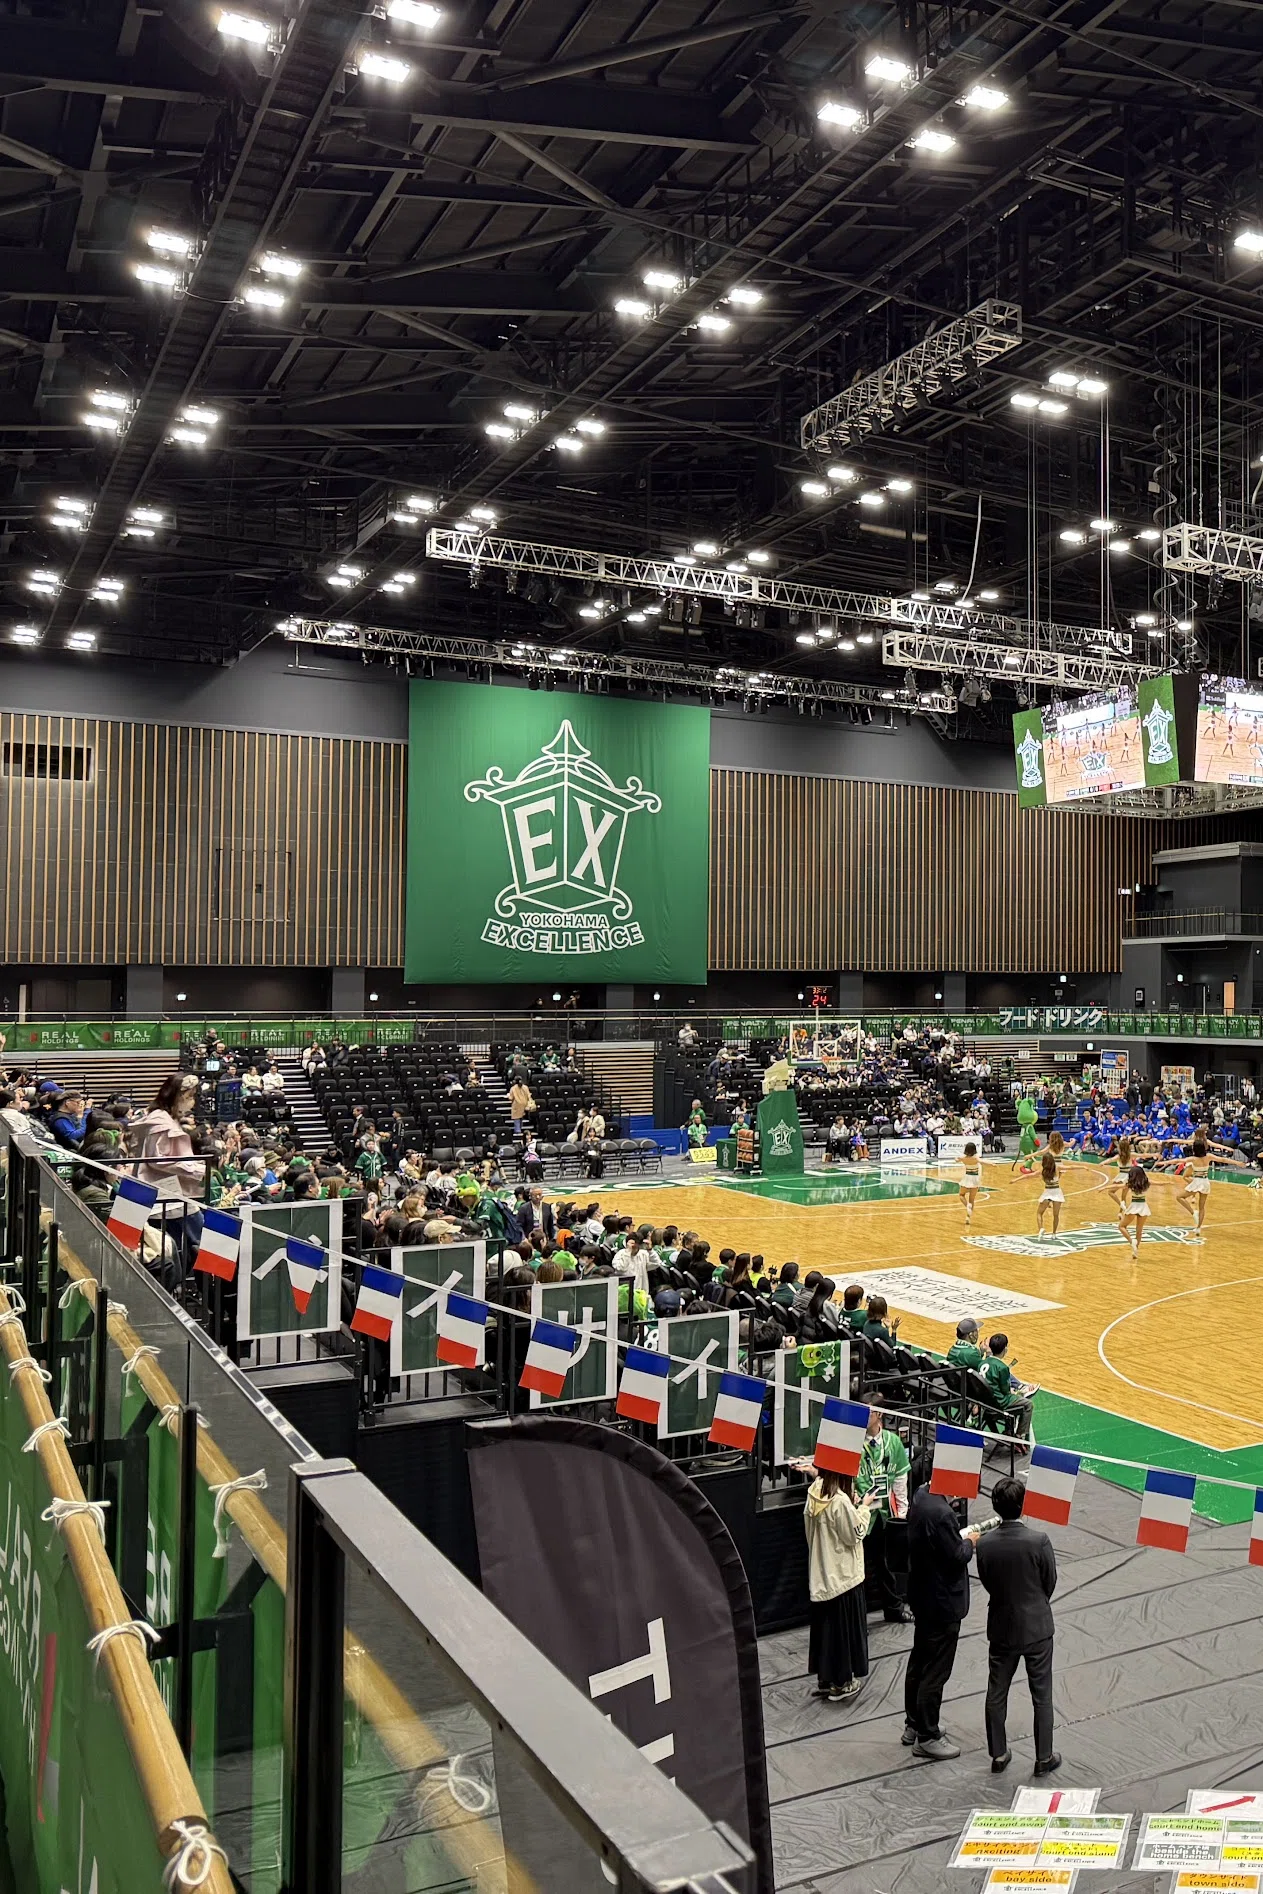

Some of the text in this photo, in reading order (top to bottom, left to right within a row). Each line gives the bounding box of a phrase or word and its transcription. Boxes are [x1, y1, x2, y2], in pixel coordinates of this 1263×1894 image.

[513, 796, 618, 888] EX
[519, 912, 609, 928] YOKOHAMA
[481, 918, 645, 954] EXCELLENCE
[812, 995, 827, 1006] 24
[1000, 1009, 1103, 1028] フード ドリンク
[883, 1147, 924, 1155] ANDEX
